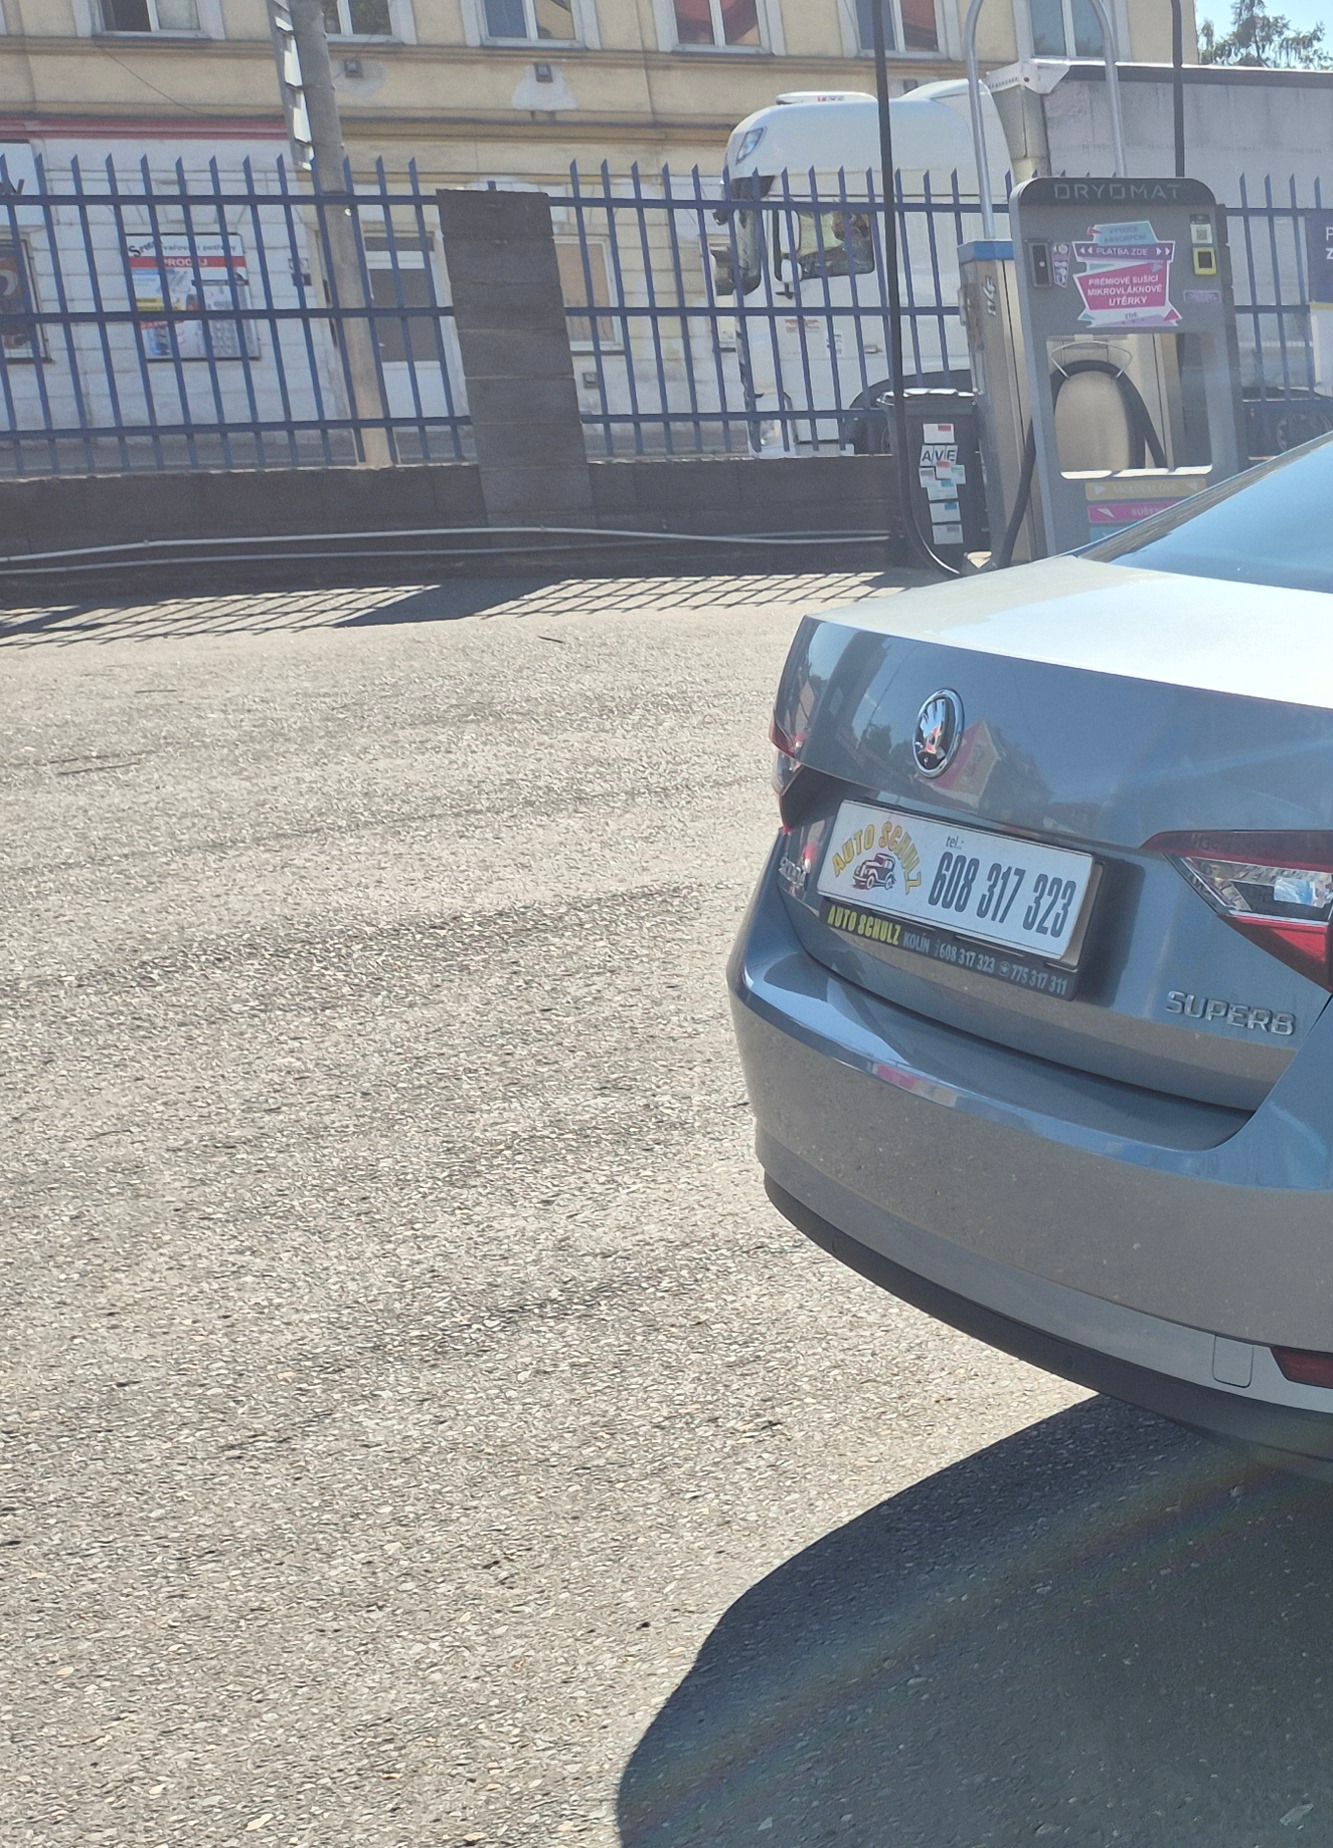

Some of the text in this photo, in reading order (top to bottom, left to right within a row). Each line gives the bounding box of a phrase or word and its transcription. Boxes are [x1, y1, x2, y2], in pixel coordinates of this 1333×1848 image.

[1054, 183, 1180, 200] DRYOMAT
[922, 449, 956, 462] AVE
[832, 823, 876, 878] AUTO
[878, 821, 922, 895] SCHULZ
[928, 851, 1077, 938] 608 317 323
[827, 905, 857, 932] AUTO
[857, 914, 902, 945] SCHULZ
[940, 943, 957, 963] 608
[958, 948, 976, 968] 317
[977, 952, 995, 974] 323
[1029, 969, 1048, 990] 317
[1165, 990, 1297, 1036] SUPERB
